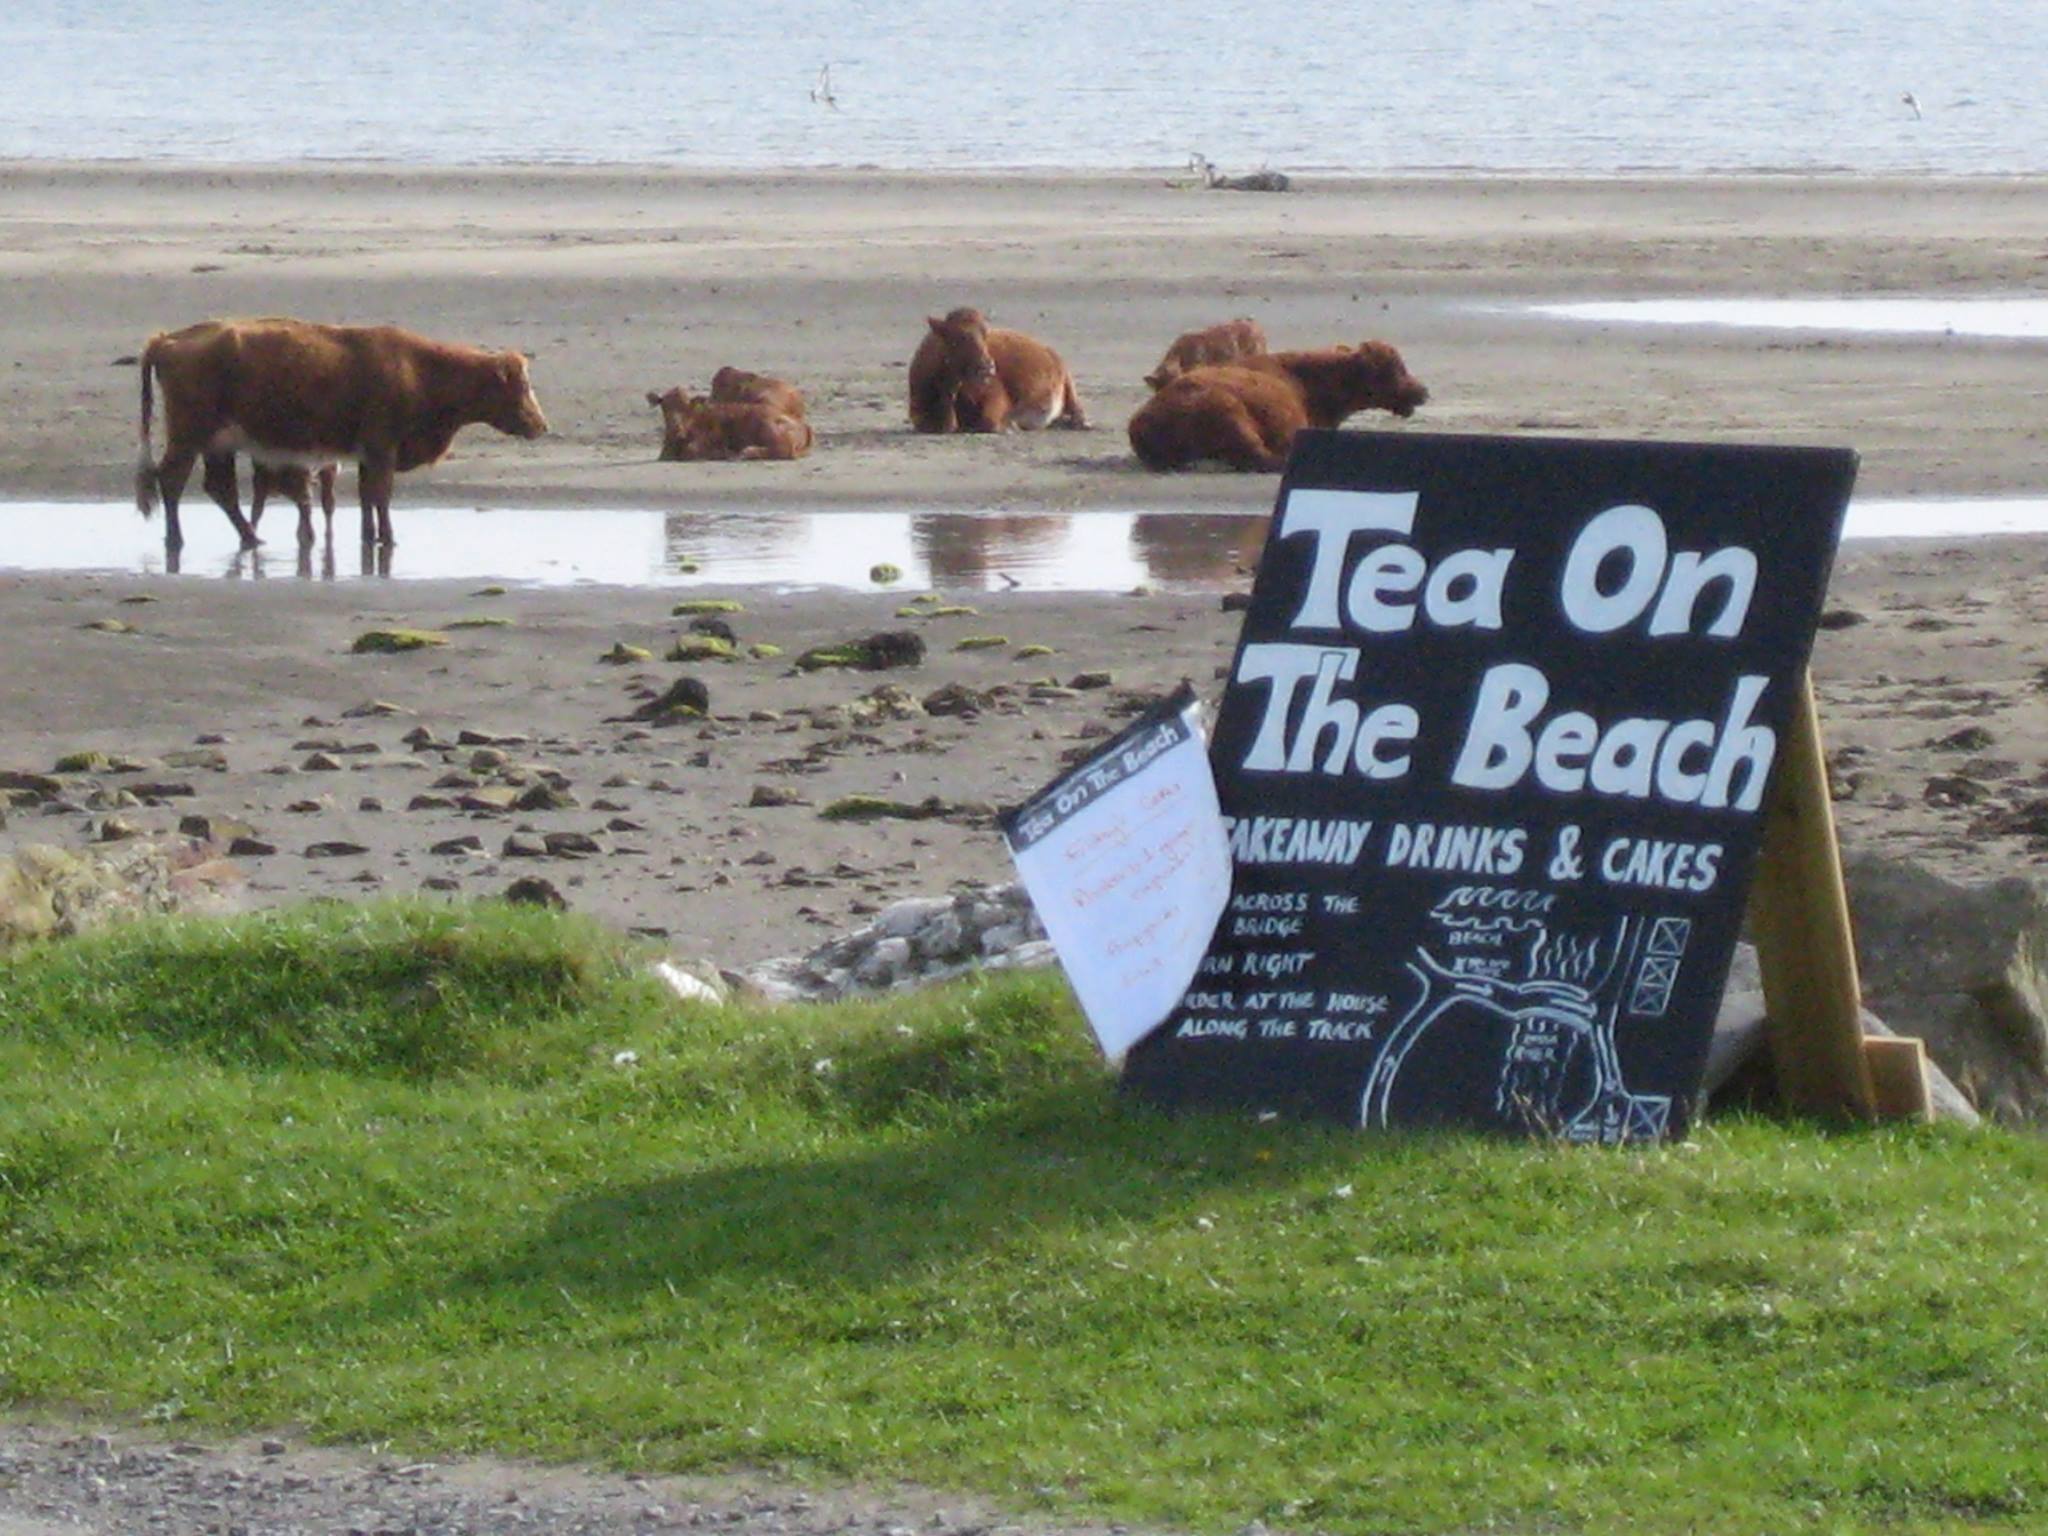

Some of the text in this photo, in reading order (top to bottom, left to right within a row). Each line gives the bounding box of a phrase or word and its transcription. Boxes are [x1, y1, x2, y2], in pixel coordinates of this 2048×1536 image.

[1280, 488, 1759, 639] Tea On
[1237, 643, 1777, 813] The Beach
[1018, 812, 1054, 843] Tea
[1055, 784, 1088, 815] On
[1086, 766, 1121, 791] The
[1121, 724, 1180, 773] Beach
[1386, 824, 1529, 875] DRINKS
[1548, 825, 1585, 880] &
[1602, 838, 1724, 892] CAKES
[1232, 893, 1360, 913] ACROSS THE
[1234, 917, 1304, 937] BRIDGE
[1242, 952, 1316, 979] RIGHT
[1244, 991, 1276, 1010] AT
[1279, 991, 1314, 1010] THE
[1326, 992, 1390, 1014] HOUSE
[1176, 1018, 1375, 1041] ALONG THE TRACK
